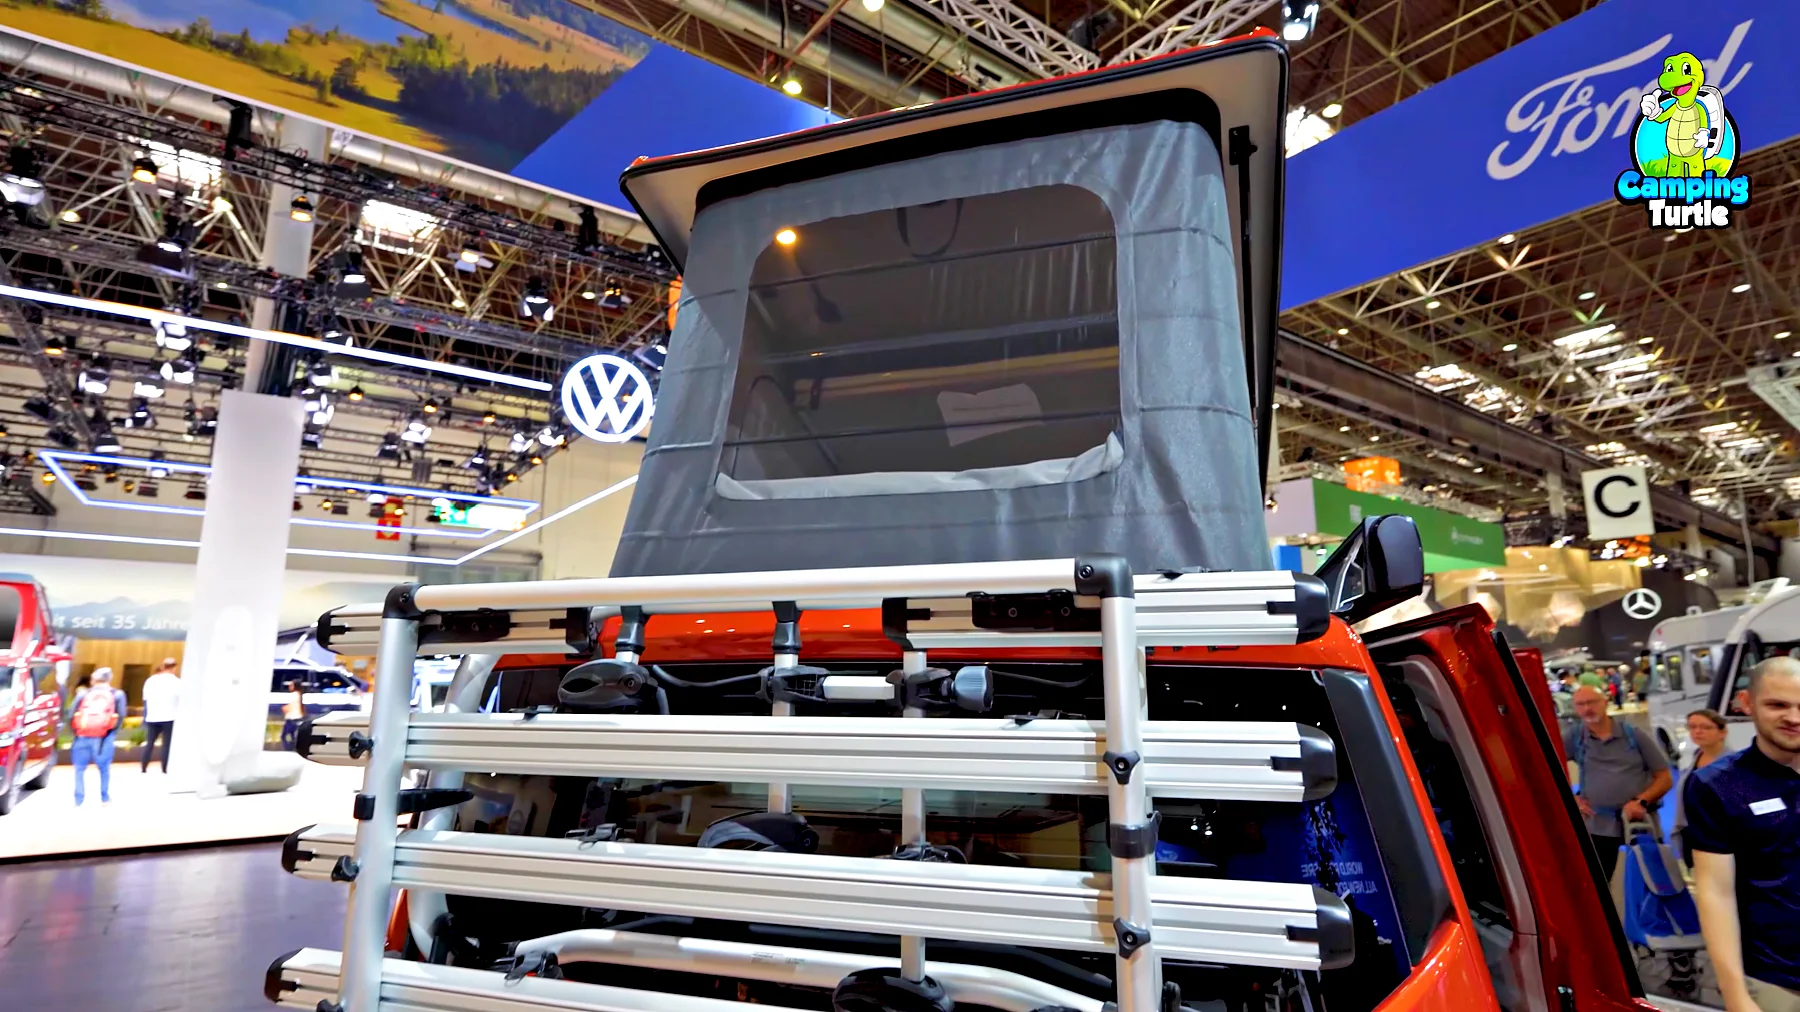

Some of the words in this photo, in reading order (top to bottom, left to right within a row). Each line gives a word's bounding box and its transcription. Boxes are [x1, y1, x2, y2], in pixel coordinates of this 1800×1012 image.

[1594, 475, 1640, 518] C
[71, 614, 106, 629] seit
[112, 614, 137, 630] 35
